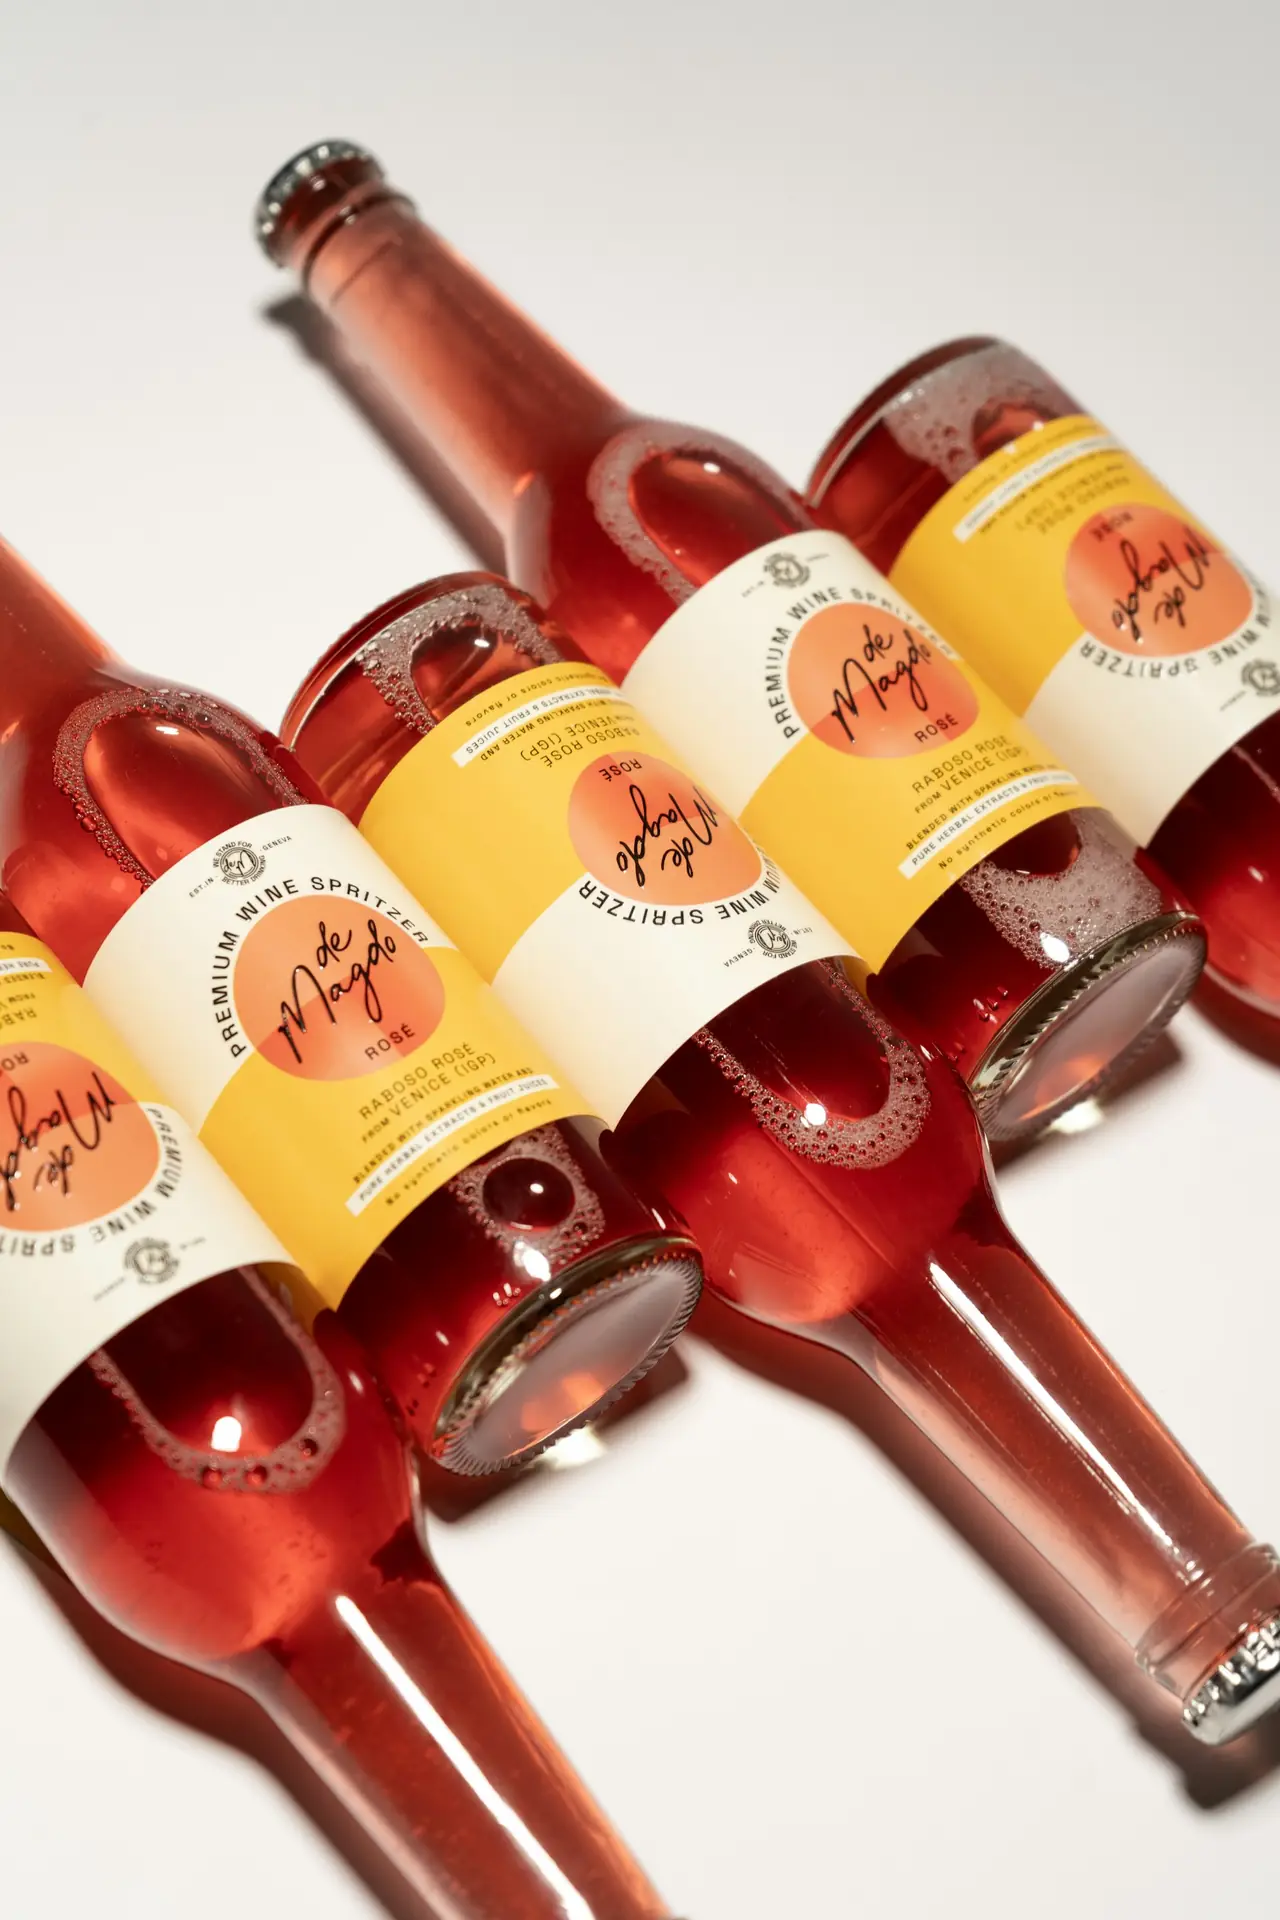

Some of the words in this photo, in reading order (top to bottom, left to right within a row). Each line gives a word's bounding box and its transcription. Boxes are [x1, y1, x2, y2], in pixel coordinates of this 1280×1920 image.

[1154, 585, 1187, 628] de
[863, 624, 894, 662] de
[1080, 640, 1199, 679] SPRITZER
[1208, 629, 1261, 667] WINE
[765, 626, 800, 738] PREMIUM
[786, 586, 843, 621] WINE
[507, 693, 518, 702] or
[520, 679, 553, 694] colors
[540, 690, 585, 709] EXTRACTS
[465, 702, 503, 727] flavors
[503, 709, 532, 728] FRUIT
[537, 702, 588, 725] SPARKLING
[565, 716, 615, 737] VENICE
[914, 713, 959, 743] ROSÉ
[465, 727, 500, 754] JUICES
[502, 723, 536, 745] WATER
[520, 733, 562, 761] (IGP)
[480, 745, 501, 761] AND
[540, 740, 584, 768] ROSÉ
[598, 758, 643, 782] ROSÉ
[911, 749, 974, 794] RABOSO
[914, 791, 942, 815] FROM
[940, 756, 995, 791] VENICE
[906, 813, 948, 851] BLENDED
[949, 795, 973, 815] WITH
[974, 769, 1021, 798] SPARKLING
[911, 842, 937, 867] PURE
[937, 814, 974, 843] HERBAL
[973, 786, 1021, 815] EXTRACTS
[262, 836, 292, 851] GENEVA
[938, 856, 953, 870] No
[955, 817, 1008, 856] synthetic
[1009, 799, 1041, 818] colors
[213, 858, 219, 868] WE
[216, 841, 236, 858] STAND
[238, 841, 252, 849] FOR
[222, 877, 249, 886] BETTER
[250, 855, 266, 882] DRINKING
[661, 837, 694, 878] de
[578, 880, 704, 926] SPRITZER
[714, 890, 770, 920] WINE
[316, 921, 352, 968] de
[723, 948, 753, 967] GENEVA
[762, 950, 777, 959] FOR
[211, 931, 246, 1058] PREMIUM
[236, 879, 298, 922] WINE
[311, 876, 428, 943] SPRITZER
[364, 1023, 415, 1060] ROSÉ
[359, 1066, 429, 1120] RABOSO
[431, 1042, 475, 1070] ROSÉ
[362, 1117, 390, 1144] FROM
[389, 1072, 451, 1117] VENICE
[454, 1052, 496, 1077] (IGP)
[353, 1142, 396, 1184] BLENDED
[398, 1120, 424, 1142] WITH
[425, 1086, 480, 1122] SPARKLING
[483, 1071, 514, 1090] WATER
[359, 1176, 383, 1202] PURE
[385, 1143, 423, 1174] HERBAL
[424, 1106, 477, 1142] EXTRACTS
[487, 1087, 516, 1103] FRUIT
[33, 1144, 74, 1197] de
[147, 1107, 183, 1199] PREMIUM
[89, 1199, 156, 1243] WINE
